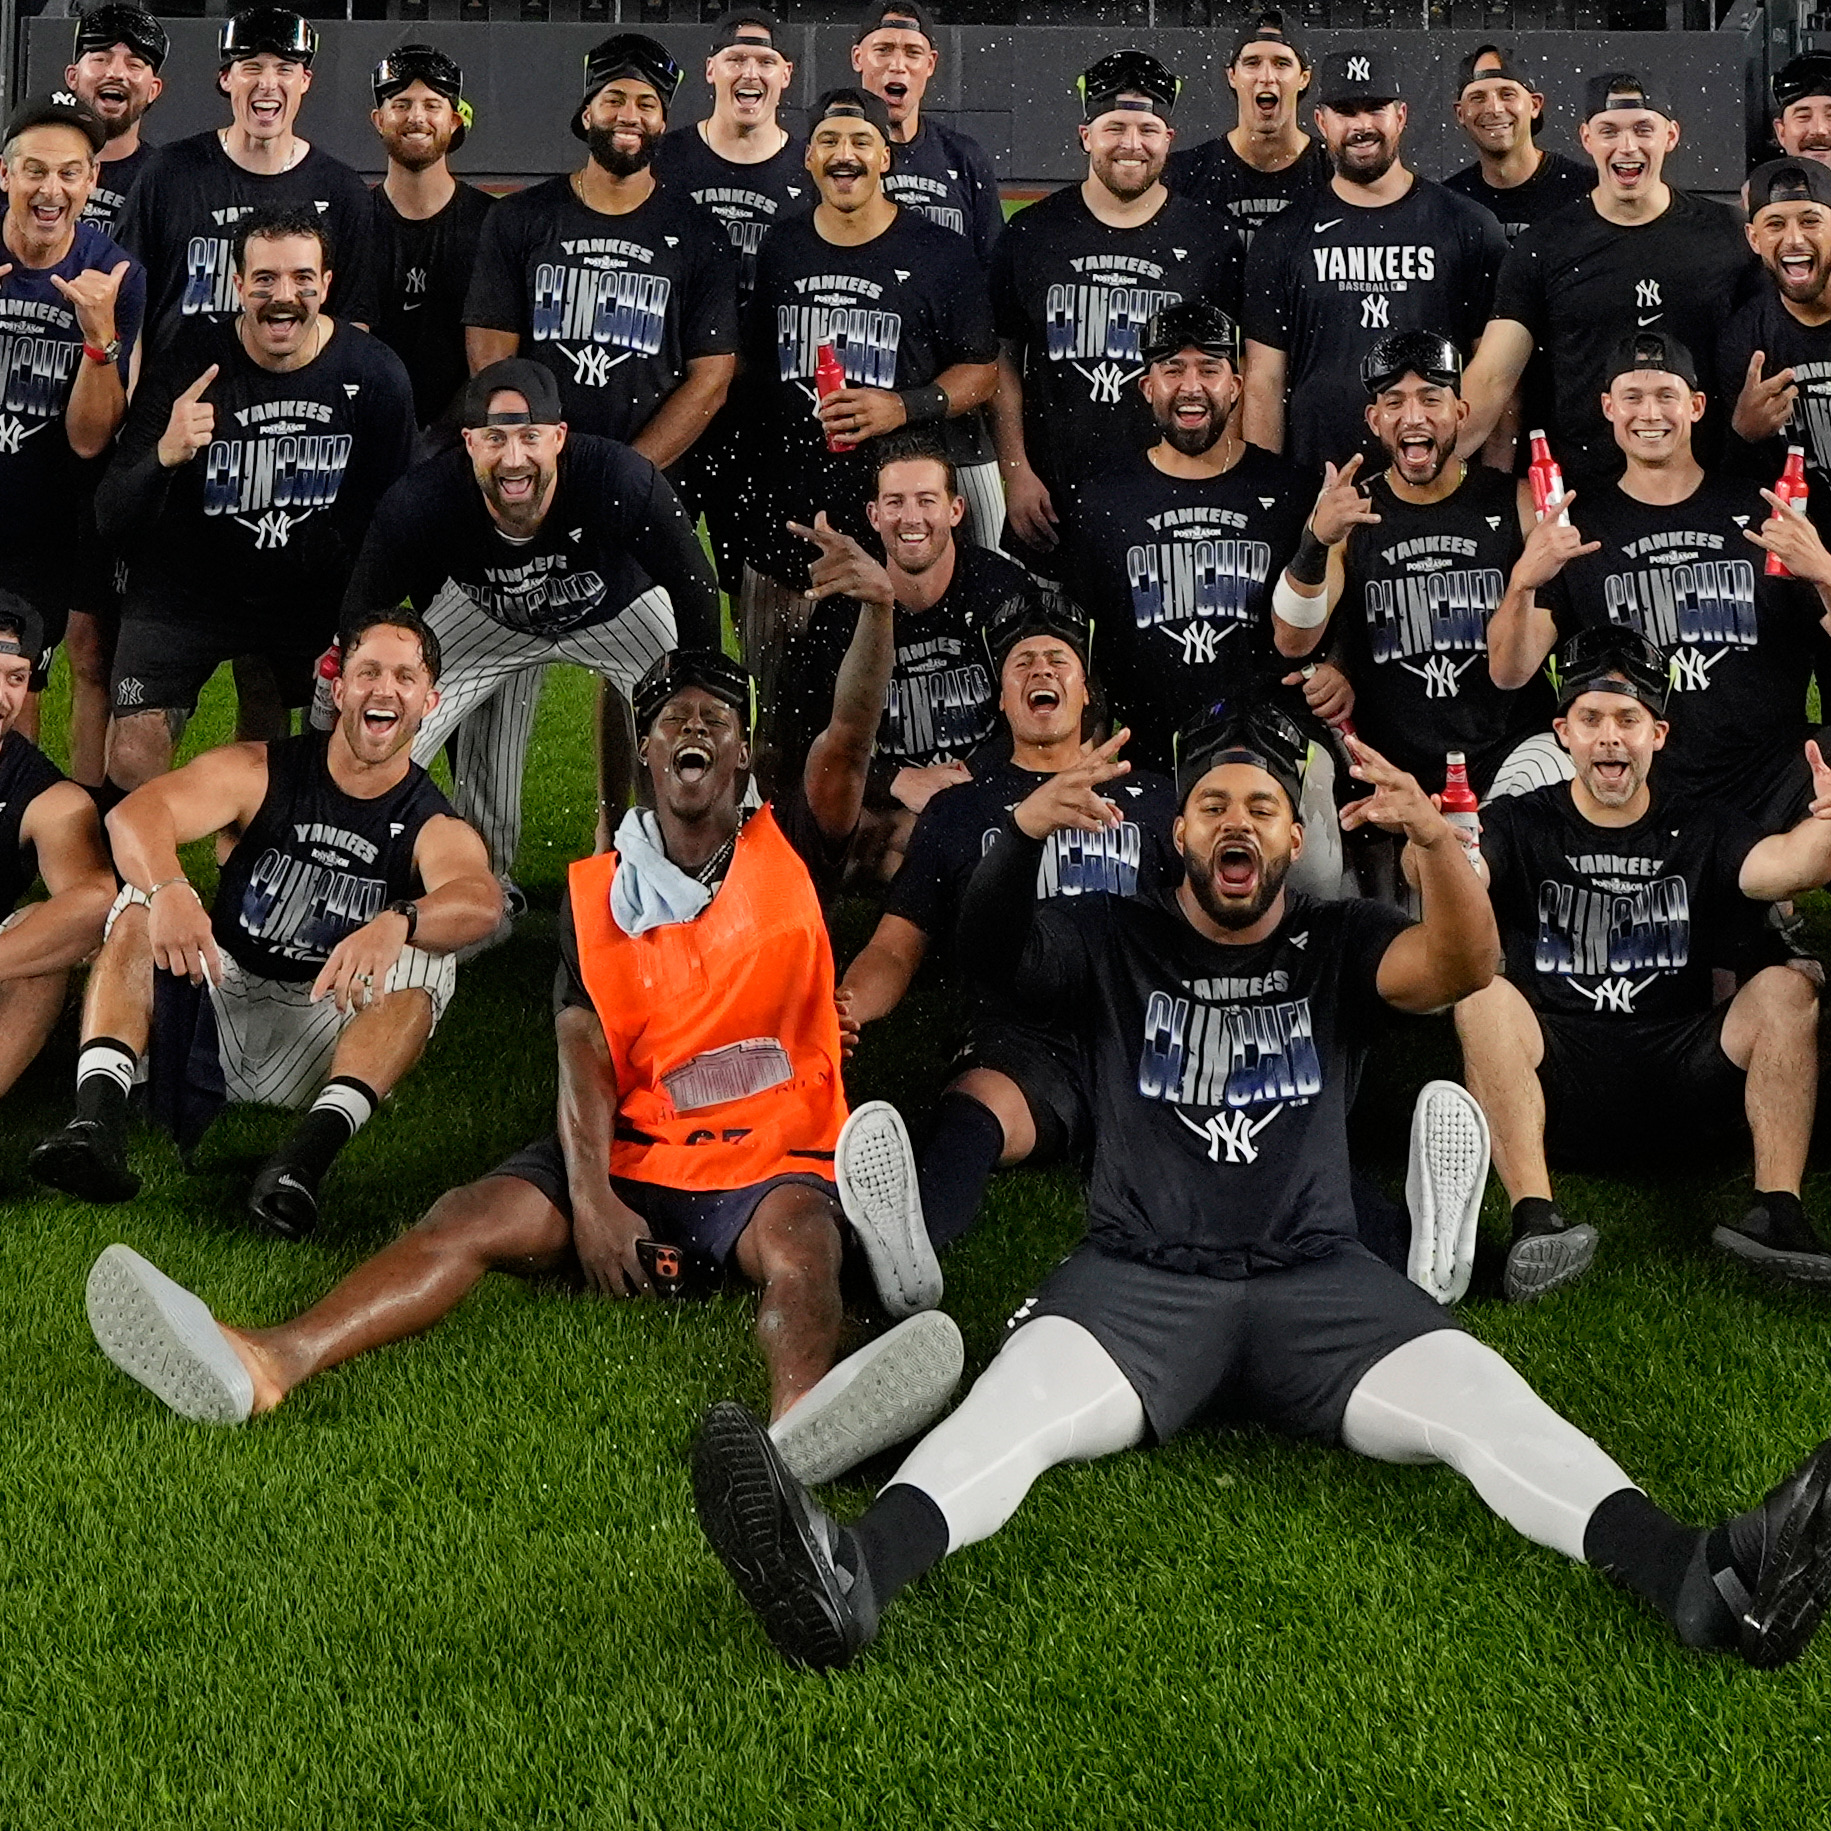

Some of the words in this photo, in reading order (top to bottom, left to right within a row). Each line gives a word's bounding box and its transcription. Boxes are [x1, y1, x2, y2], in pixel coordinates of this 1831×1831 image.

[560, 240, 656, 265] YANKEES
[1312, 244, 1436, 283] YANKEES
[1337, 280, 1390, 293] BASEBALL
[532, 262, 672, 356] CLINCHED
[202, 432, 354, 517] CLINCHED
[1146, 506, 1249, 533] YANKEES
[1380, 536, 1479, 566] YANKEES
[1620, 528, 1725, 557] YANKEES
[1126, 538, 1272, 632] CLINCHED
[1534, 876, 1691, 973] CLINCHED
[1137, 989, 1324, 1111] CLINCHED
